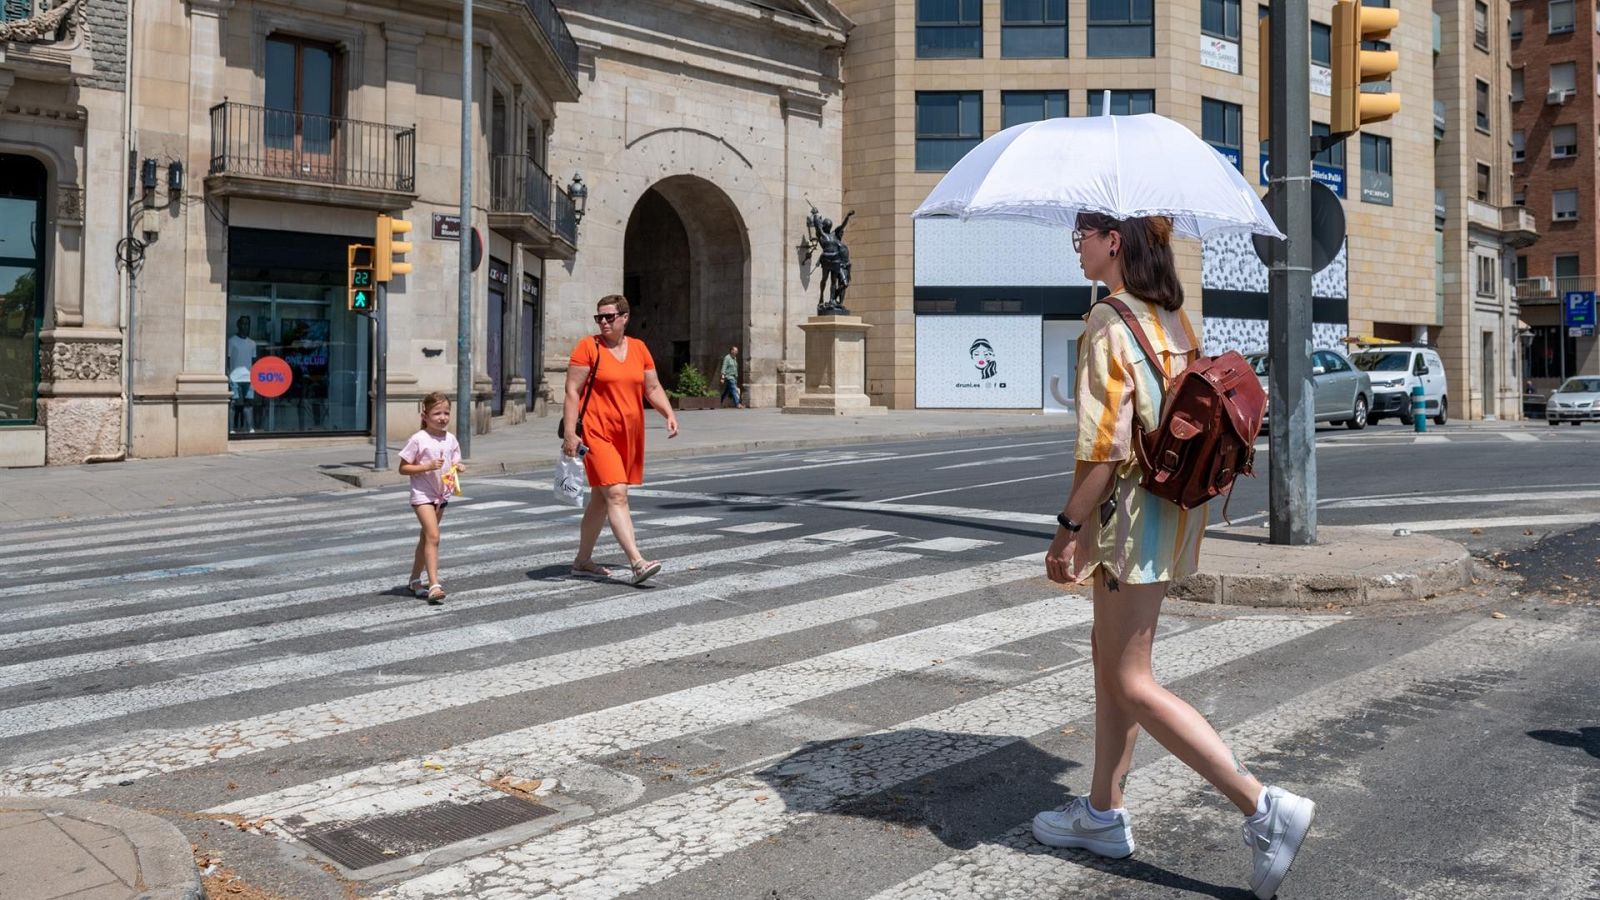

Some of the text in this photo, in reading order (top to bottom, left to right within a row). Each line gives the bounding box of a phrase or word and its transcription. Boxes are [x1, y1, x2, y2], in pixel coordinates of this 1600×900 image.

[355, 271, 368, 284] 22
[1570, 294, 1583, 309] P
[258, 371, 285, 383] 50%
